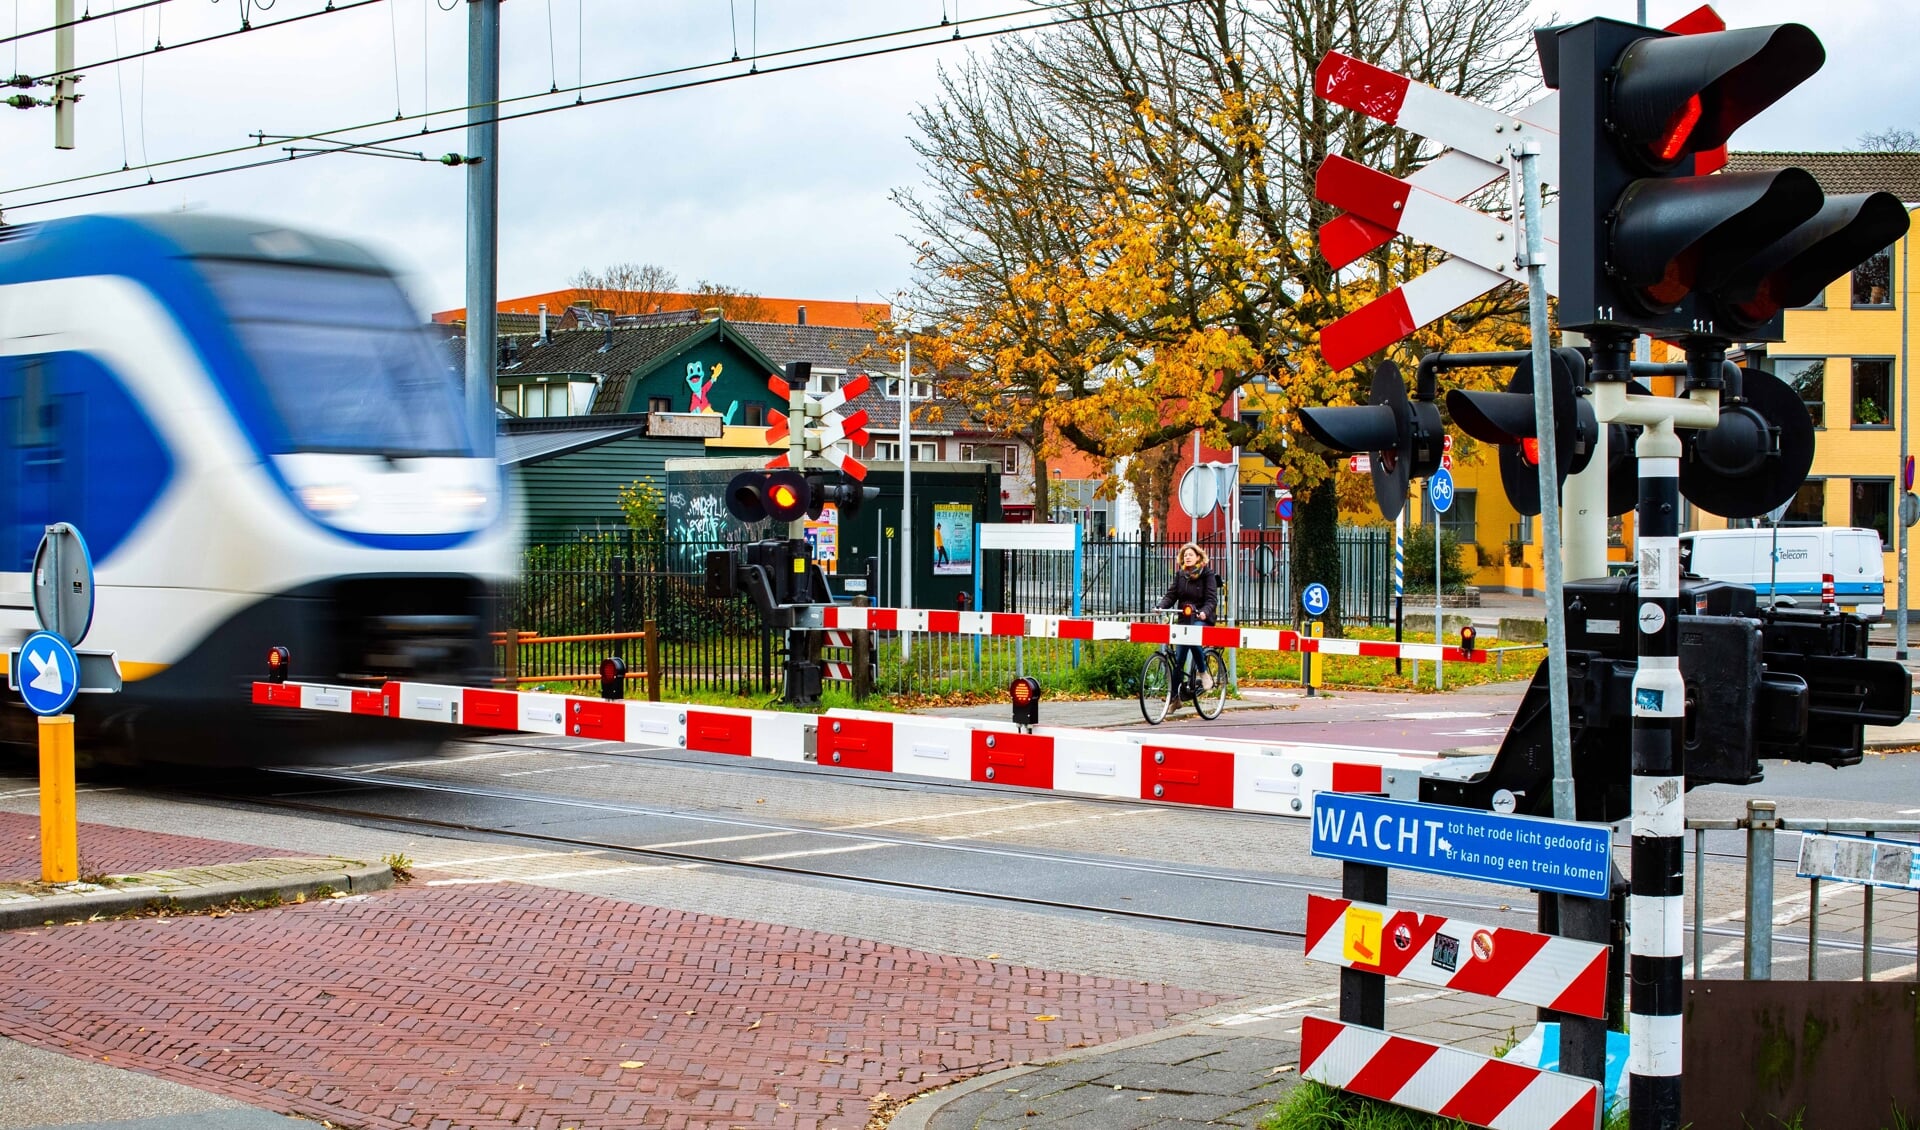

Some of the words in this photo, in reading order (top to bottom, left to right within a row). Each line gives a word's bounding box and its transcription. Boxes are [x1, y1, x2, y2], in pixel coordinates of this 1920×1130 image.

[1597, 305, 1613, 320] 1.1
[1778, 550, 1808, 560] Telecom
[1316, 806, 1444, 857] WACHT
[1448, 821, 1464, 834] tot
[1467, 822, 1485, 838] het
[1488, 827, 1513, 841] rode
[1515, 829, 1542, 845] licht
[1544, 835, 1592, 852] gedoofd
[1595, 839, 1606, 853] is
[1446, 849, 1458, 860] er
[1460, 849, 1480, 863] kan
[1483, 854, 1505, 869] nog
[1507, 857, 1529, 870] een
[1532, 859, 1560, 875] trein
[1563, 863, 1604, 881] komen
